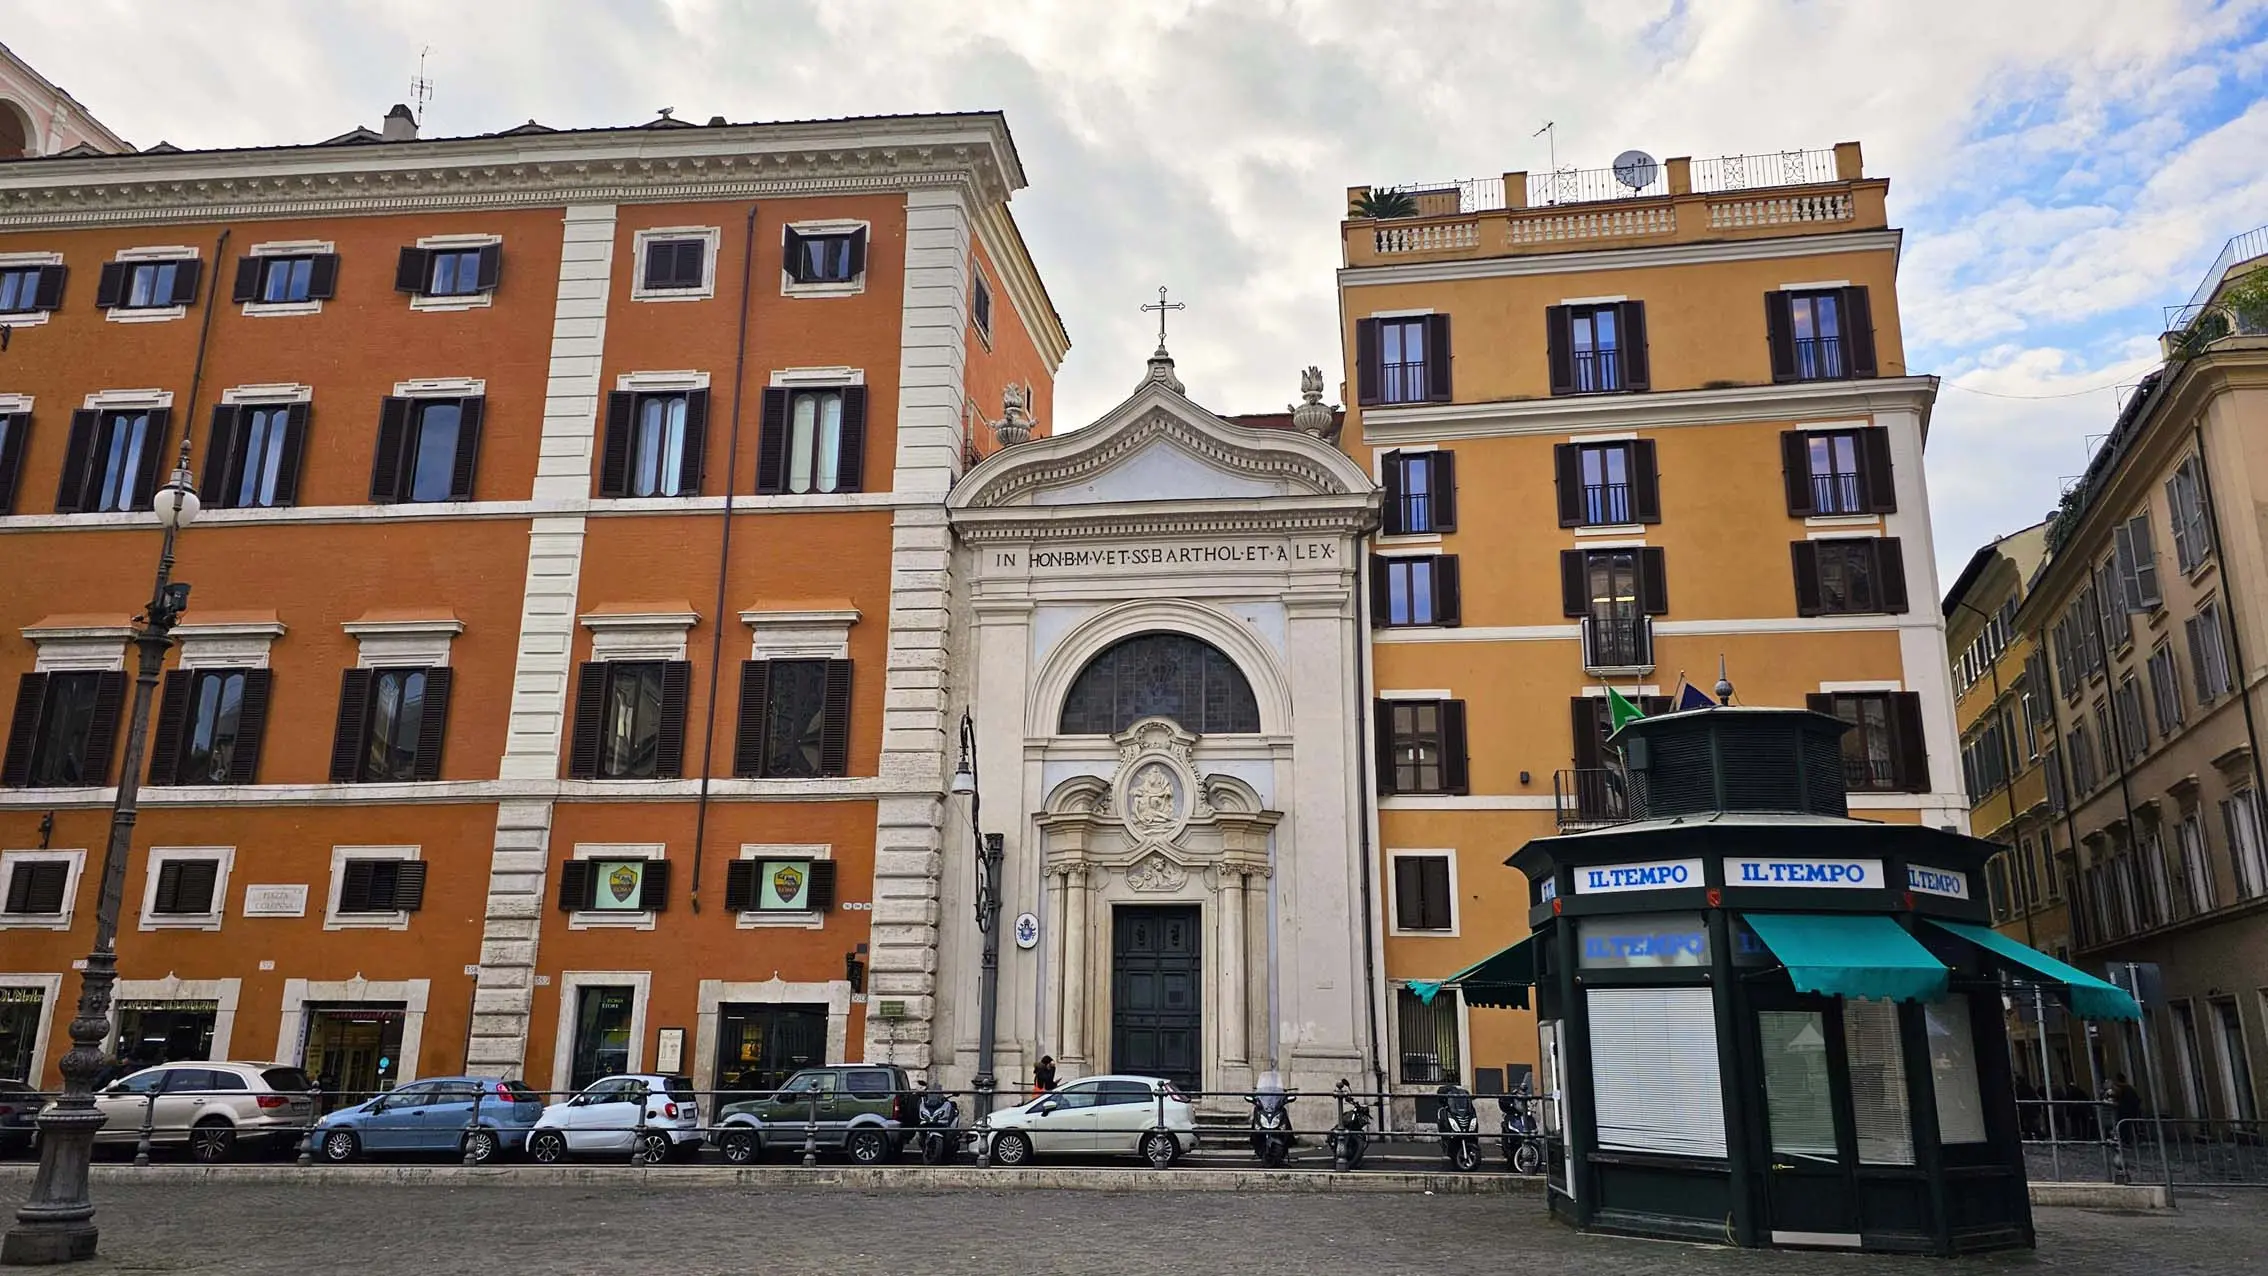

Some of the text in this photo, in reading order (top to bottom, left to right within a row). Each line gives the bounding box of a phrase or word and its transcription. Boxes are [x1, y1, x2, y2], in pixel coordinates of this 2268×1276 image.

[996, 553, 1016, 567] IN
[1588, 865, 1688, 888] IL TEMPO
[1741, 863, 1865, 882] IL TEMPO
[1907, 868, 1960, 894] IL TEMPO
[1609, 932, 1704, 959] TEMPO
